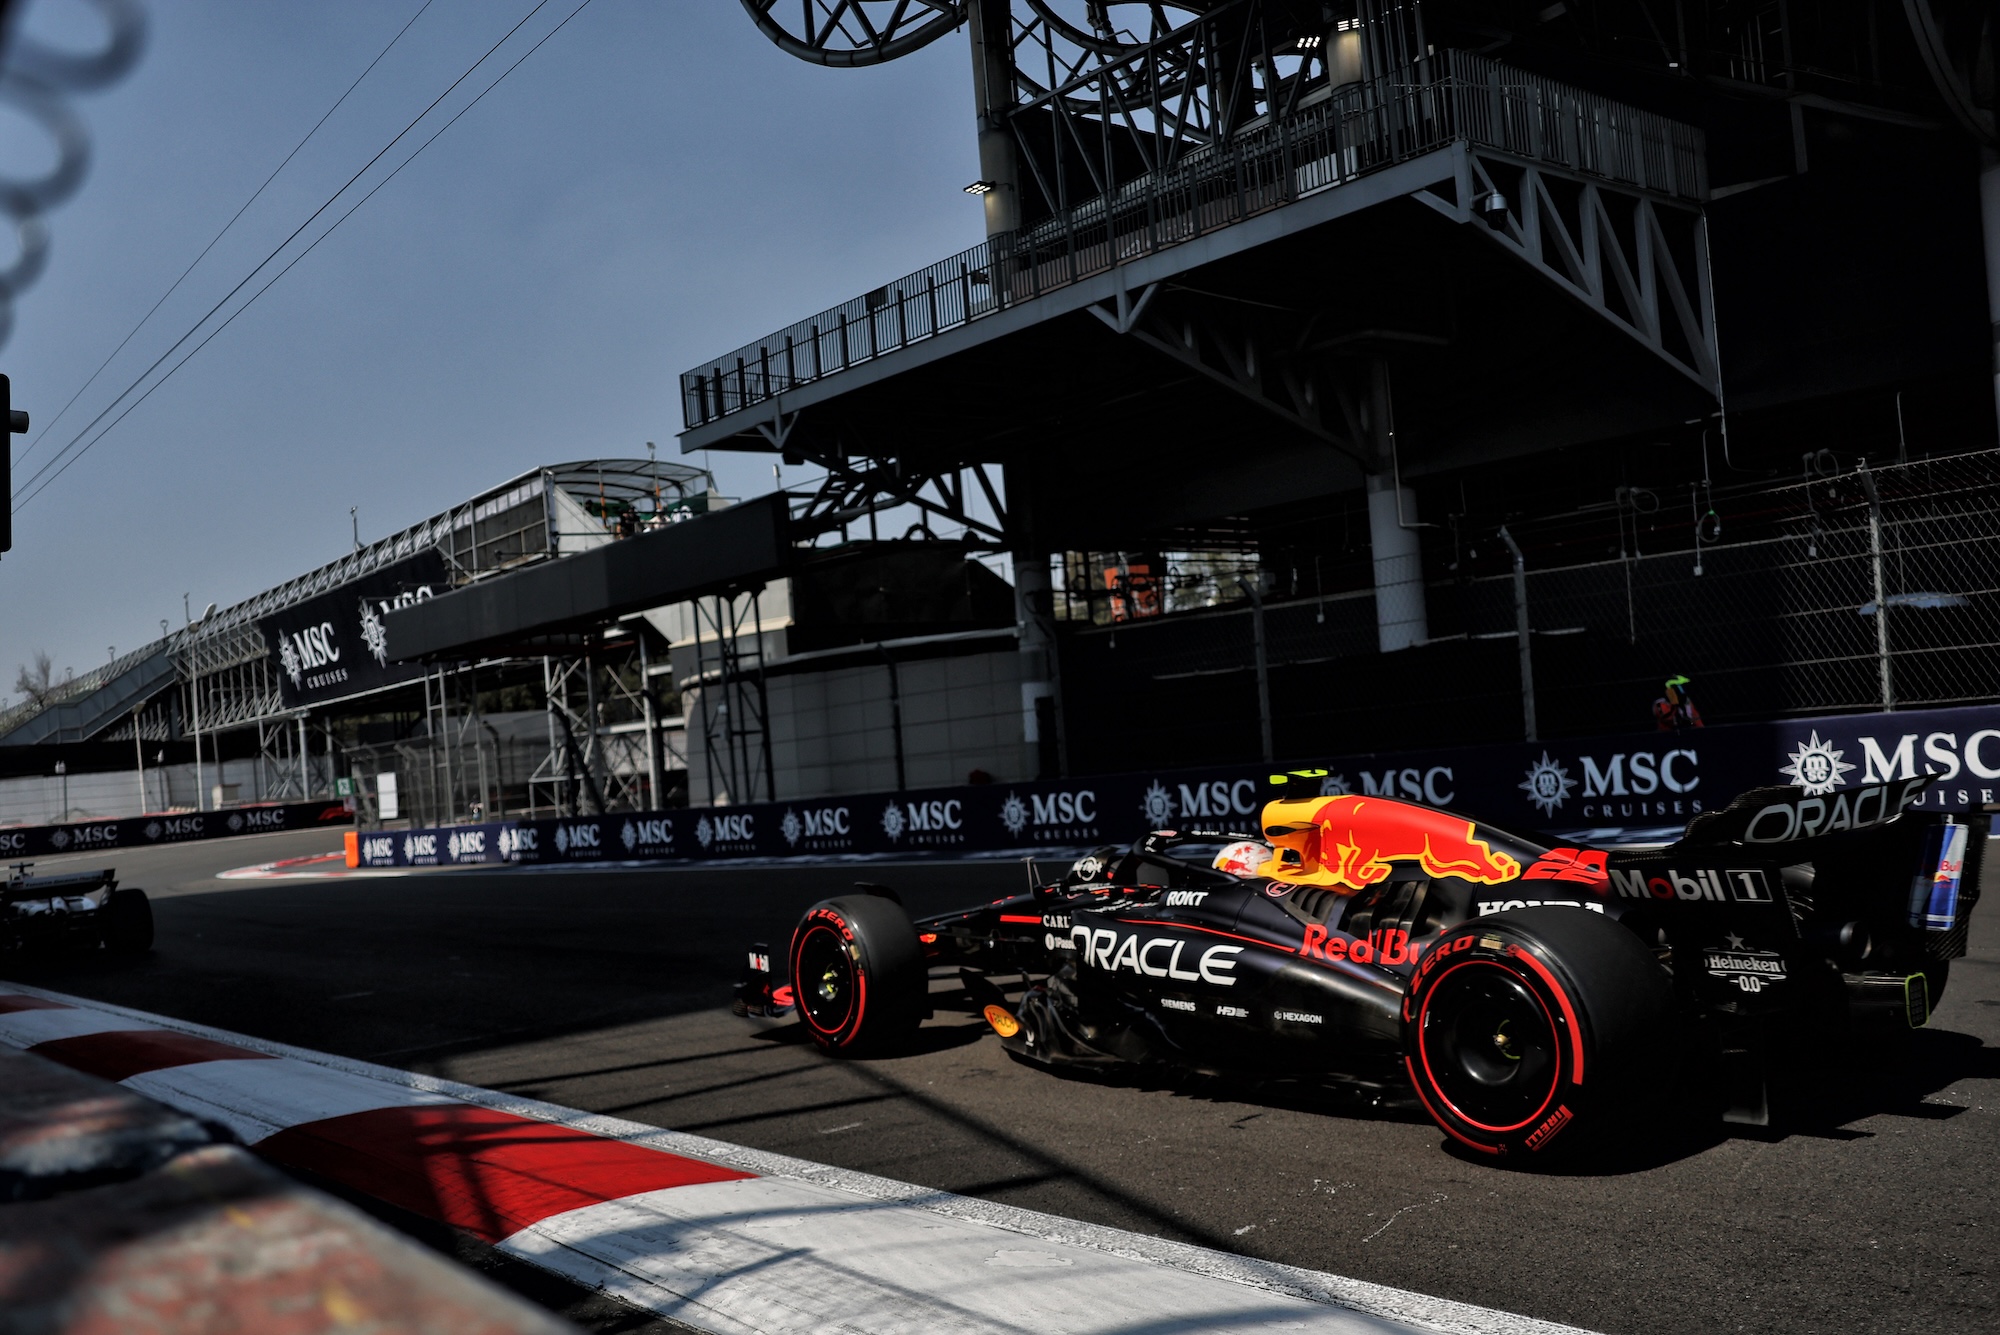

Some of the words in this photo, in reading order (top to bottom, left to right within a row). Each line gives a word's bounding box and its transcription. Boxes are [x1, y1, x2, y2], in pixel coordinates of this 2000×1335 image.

[293, 622, 340, 670] MSC
[307, 668, 349, 689] CRUISES
[1858, 729, 2000, 784] MSC
[1579, 750, 1699, 798] MSC
[1359, 766, 1454, 806] MSC
[1913, 788, 1995, 806] UISE
[1031, 790, 1096, 825] MSC
[1178, 779, 1256, 818] MSC
[1584, 801, 1702, 818] CRUISES
[165, 817, 204, 834] MSC
[247, 809, 285, 826] MSC
[803, 807, 850, 836] MSC
[907, 800, 963, 831] MSC
[73, 825, 118, 843] MSC
[510, 827, 538, 849] MSC
[569, 824, 600, 847] MSC
[637, 819, 673, 844] MSC
[714, 814, 754, 841] MSC
[0, 833, 25, 850] SC
[372, 837, 393, 857] MSC
[414, 835, 437, 855] MSC
[460, 831, 485, 853] MSC
[1609, 870, 1726, 901] Mobil
[1738, 873, 1757, 899] 1
[1166, 891, 1209, 906] ROKT
[818, 908, 854, 941] ZERO
[1070, 925, 1245, 986] ORACLE
[1300, 924, 1382, 965] Red
[1410, 935, 1475, 996] ZERO
[1708, 955, 1781, 972] Heineken
[1738, 975, 1761, 992] 0.0
[1161, 998, 1196, 1012] SIEMENS
[1283, 1012, 1322, 1024] HEXAGON
[1525, 1104, 1575, 1151] PIRELLI
